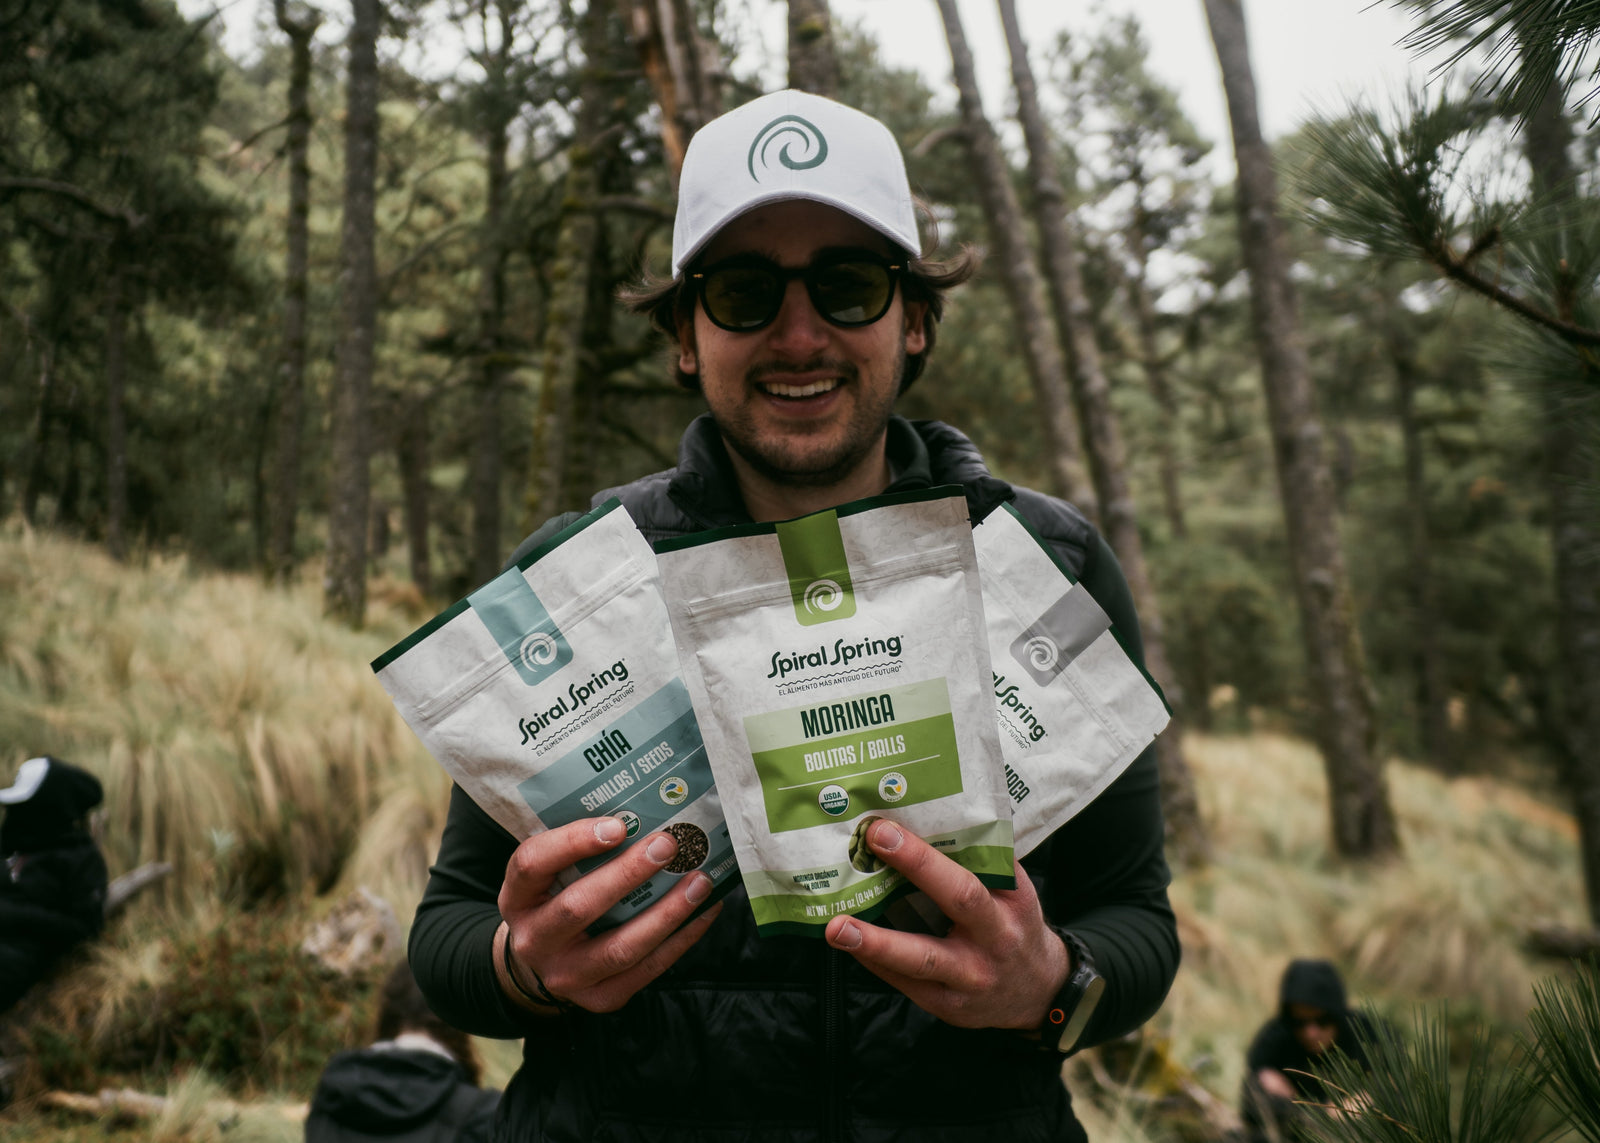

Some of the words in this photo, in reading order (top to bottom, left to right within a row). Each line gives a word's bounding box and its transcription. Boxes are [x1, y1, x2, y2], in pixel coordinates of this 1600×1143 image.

[767, 646, 828, 678] Spiral
[830, 635, 902, 665] Spring
[518, 697, 569, 745] Spiral
[568, 660, 629, 711] Spring
[787, 682, 818, 694] ALIMENTO
[819, 679, 833, 688] MÁS
[833, 675, 861, 685] ANTIGUO
[543, 732, 570, 752] ALIMENTO
[569, 725, 581, 735] MÁS
[580, 708, 603, 727] ANTIGUO
[602, 703, 613, 712] DEL
[800, 693, 896, 739] MORINGA
[995, 685, 1046, 742] Spring
[583, 729, 633, 773] CHÍA
[803, 745, 857, 773] BOLITAS
[859, 741, 865, 763] /
[867, 734, 906, 760] BALLS
[580, 769, 635, 812] SEMILLAS
[630, 762, 641, 782] /
[636, 740, 675, 775] SEEDS
[823, 791, 842, 801] USDA
[622, 814, 632, 823] DA
[823, 800, 847, 809] ORGANIC
[811, 880, 830, 890] BOLITAS
[806, 905, 816, 917] NET
[816, 905, 830, 916] WT.
[835, 900, 847, 913] 7.0
[847, 898, 856, 909] oz
